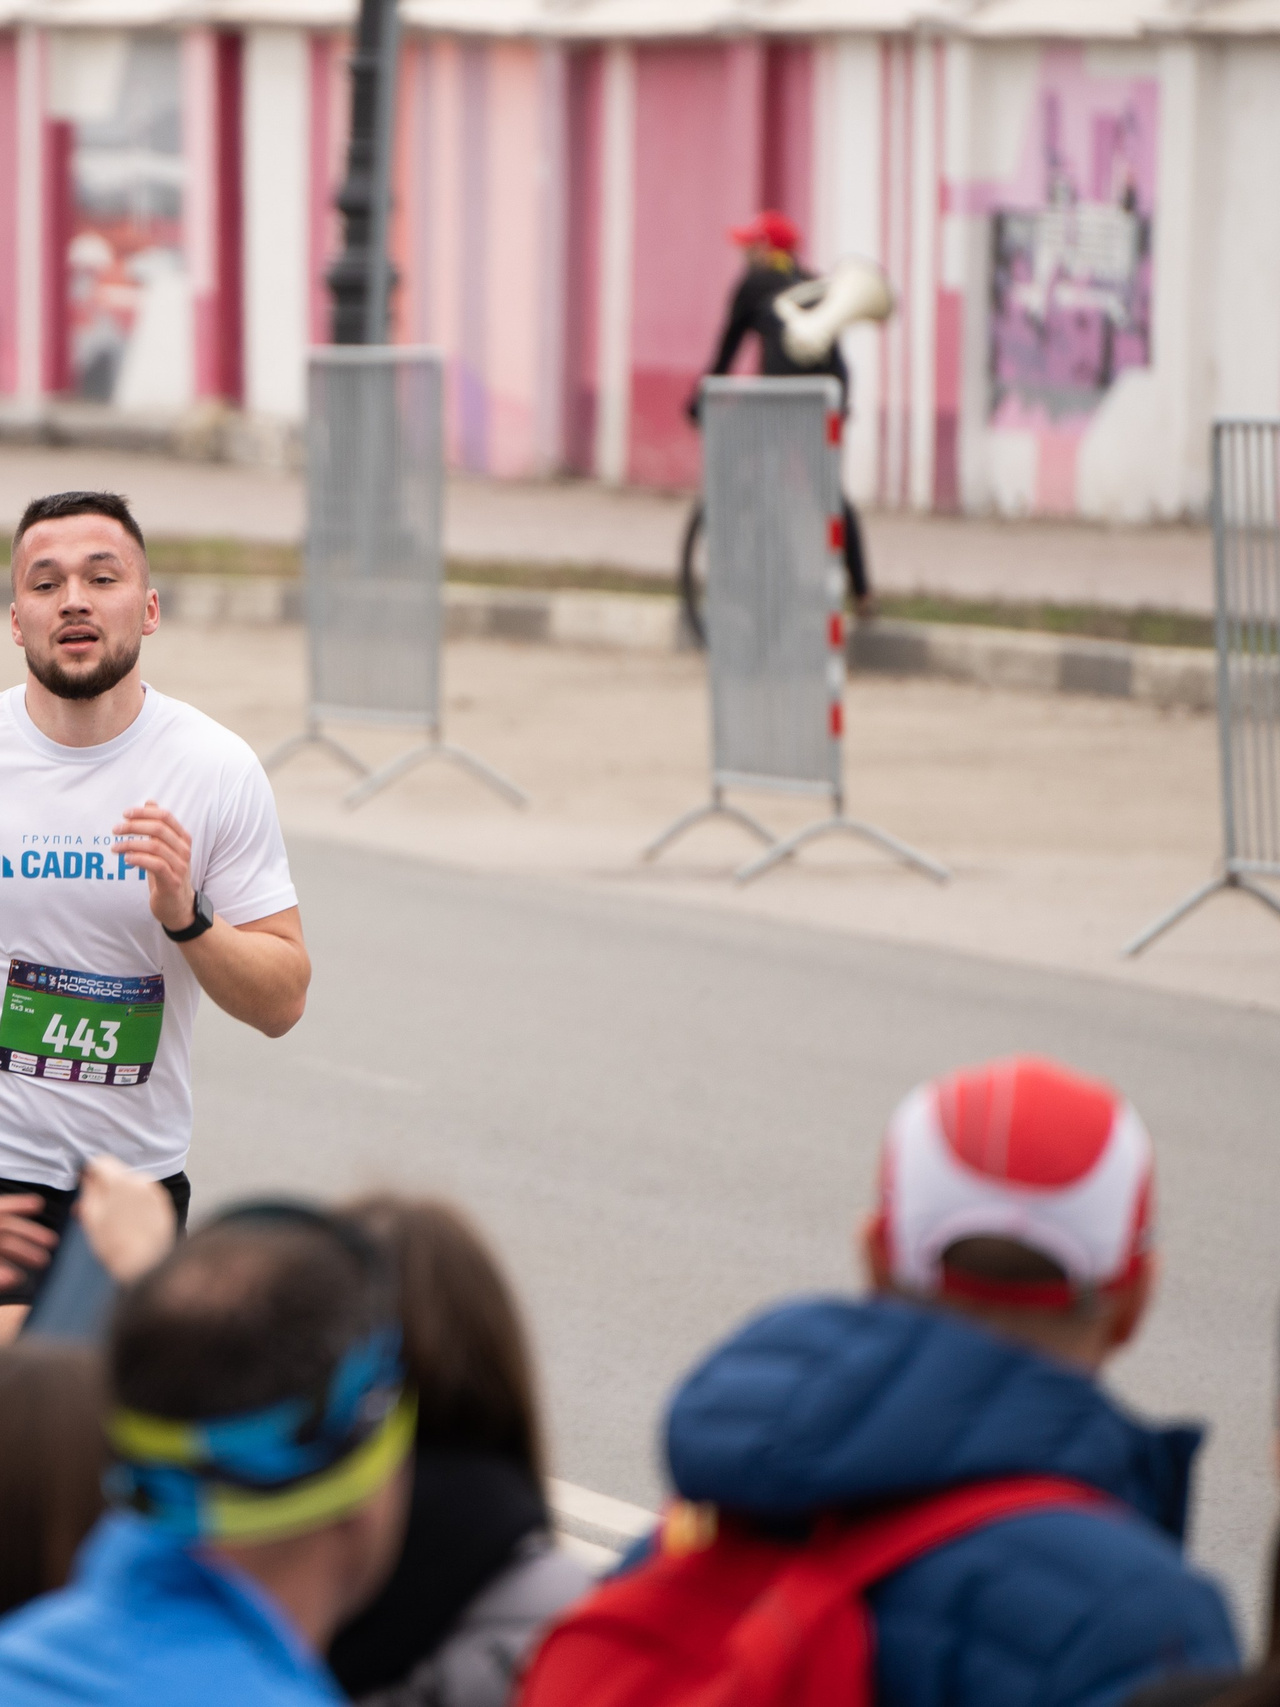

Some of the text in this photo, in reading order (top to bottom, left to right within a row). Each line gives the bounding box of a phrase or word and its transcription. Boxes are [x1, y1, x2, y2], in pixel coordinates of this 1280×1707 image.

[22, 834, 83, 845] ГРУППА
[21, 850, 146, 881] CADR.P
[58, 974, 123, 989] Я ПРОСТО
[57, 983, 122, 997] КОСМОС
[42, 1013, 121, 1060] 443
